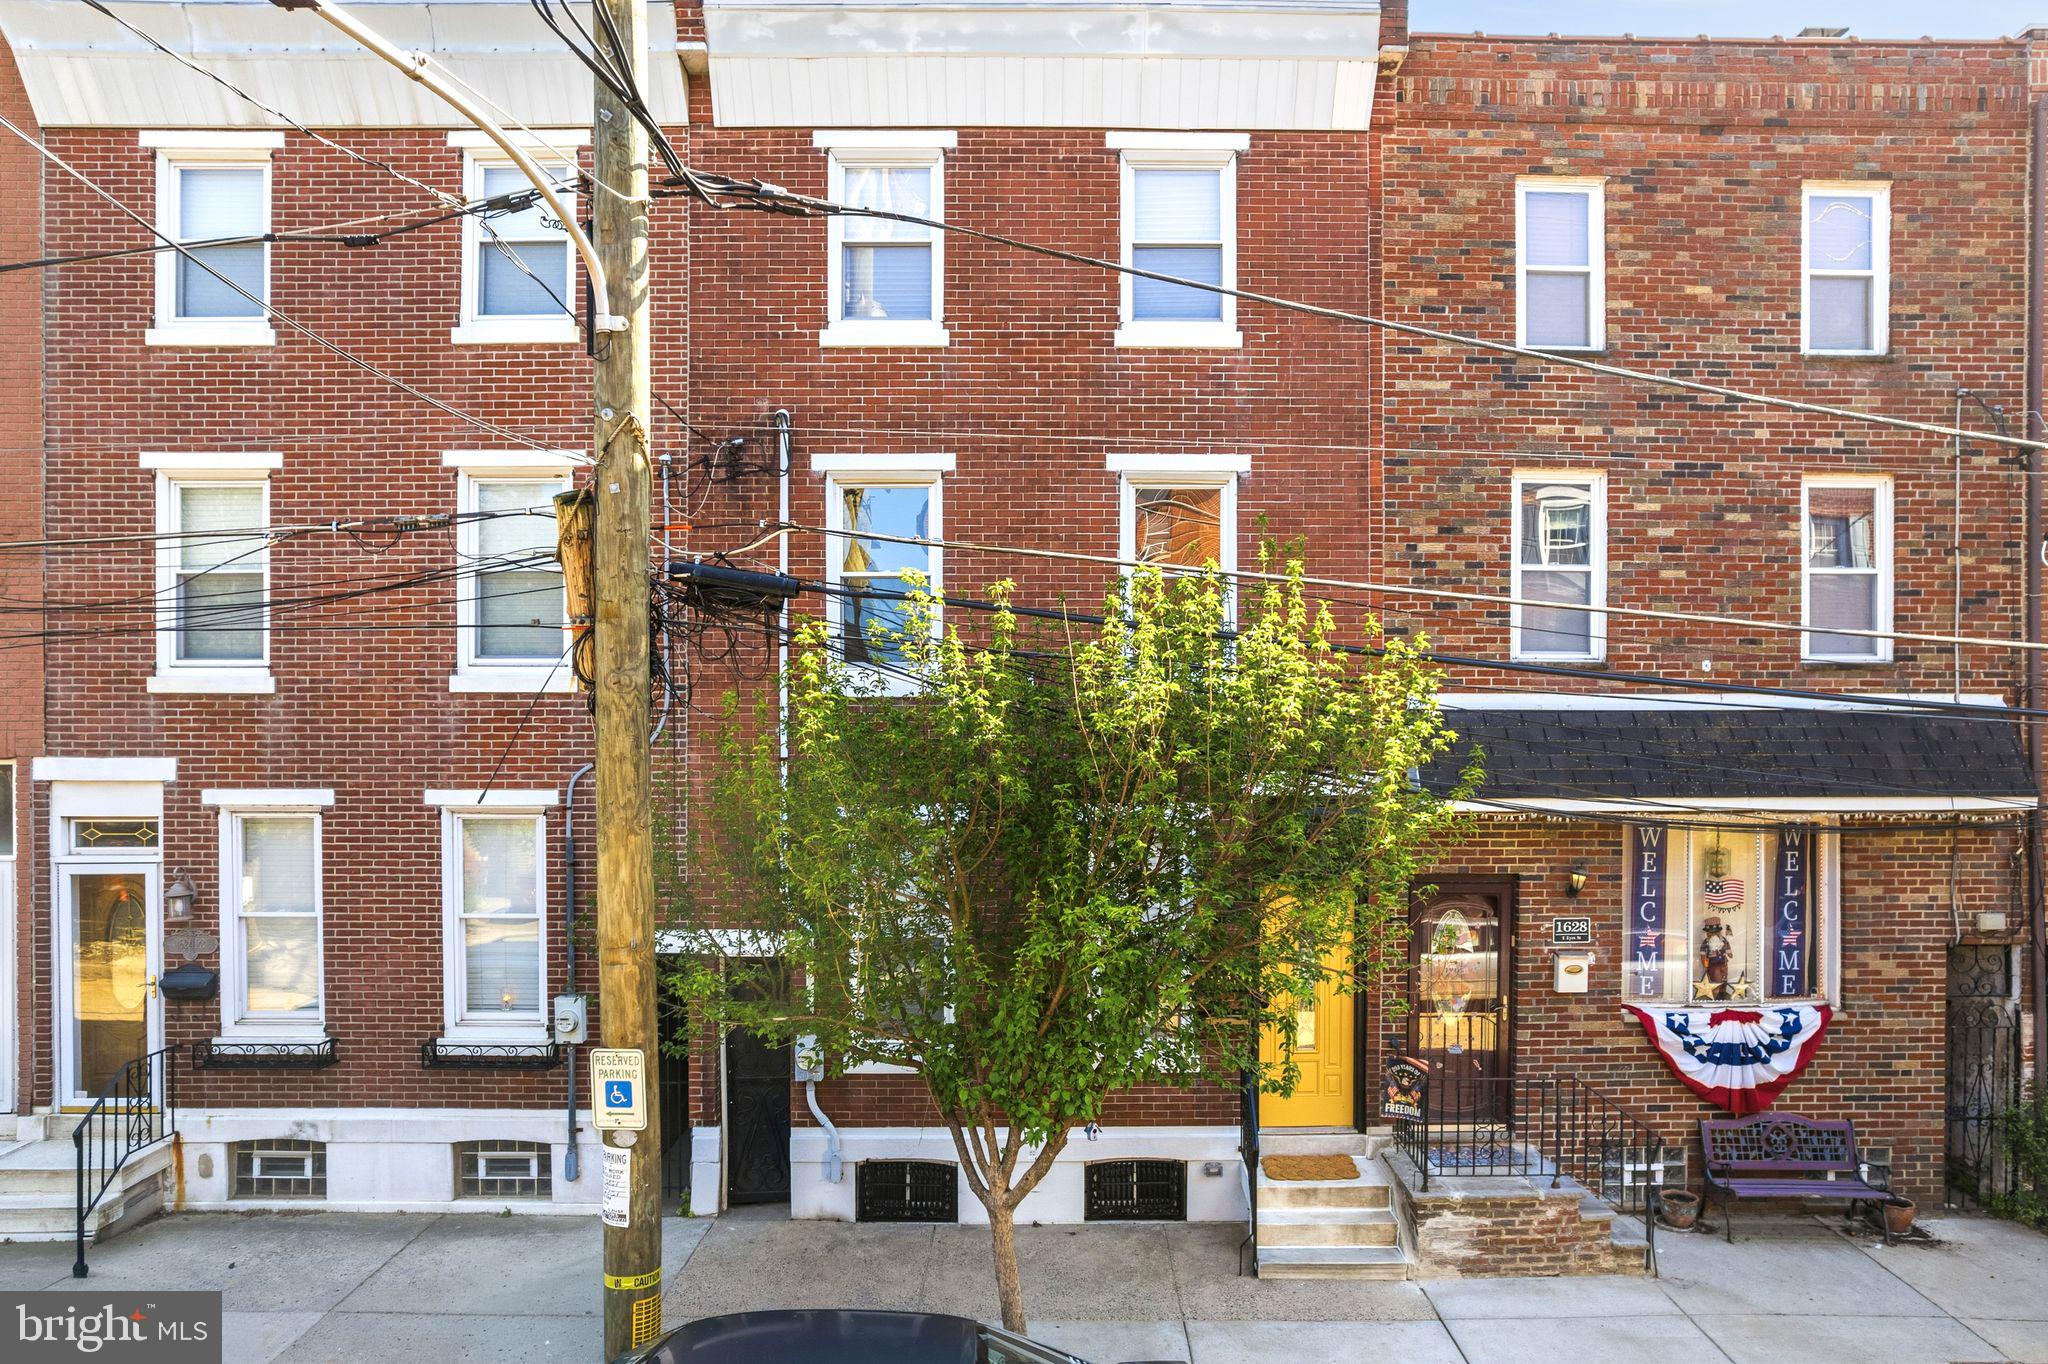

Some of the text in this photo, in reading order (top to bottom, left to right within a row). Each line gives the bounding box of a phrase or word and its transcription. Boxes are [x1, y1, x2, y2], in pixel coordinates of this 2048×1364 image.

[1555, 920, 1588, 933] 1628
[595, 1055, 640, 1066] RESERVED
[598, 1069, 638, 1080] PARKING
[1385, 1103, 1421, 1117] FREEDOM
[602, 1150, 627, 1165] ARKING
